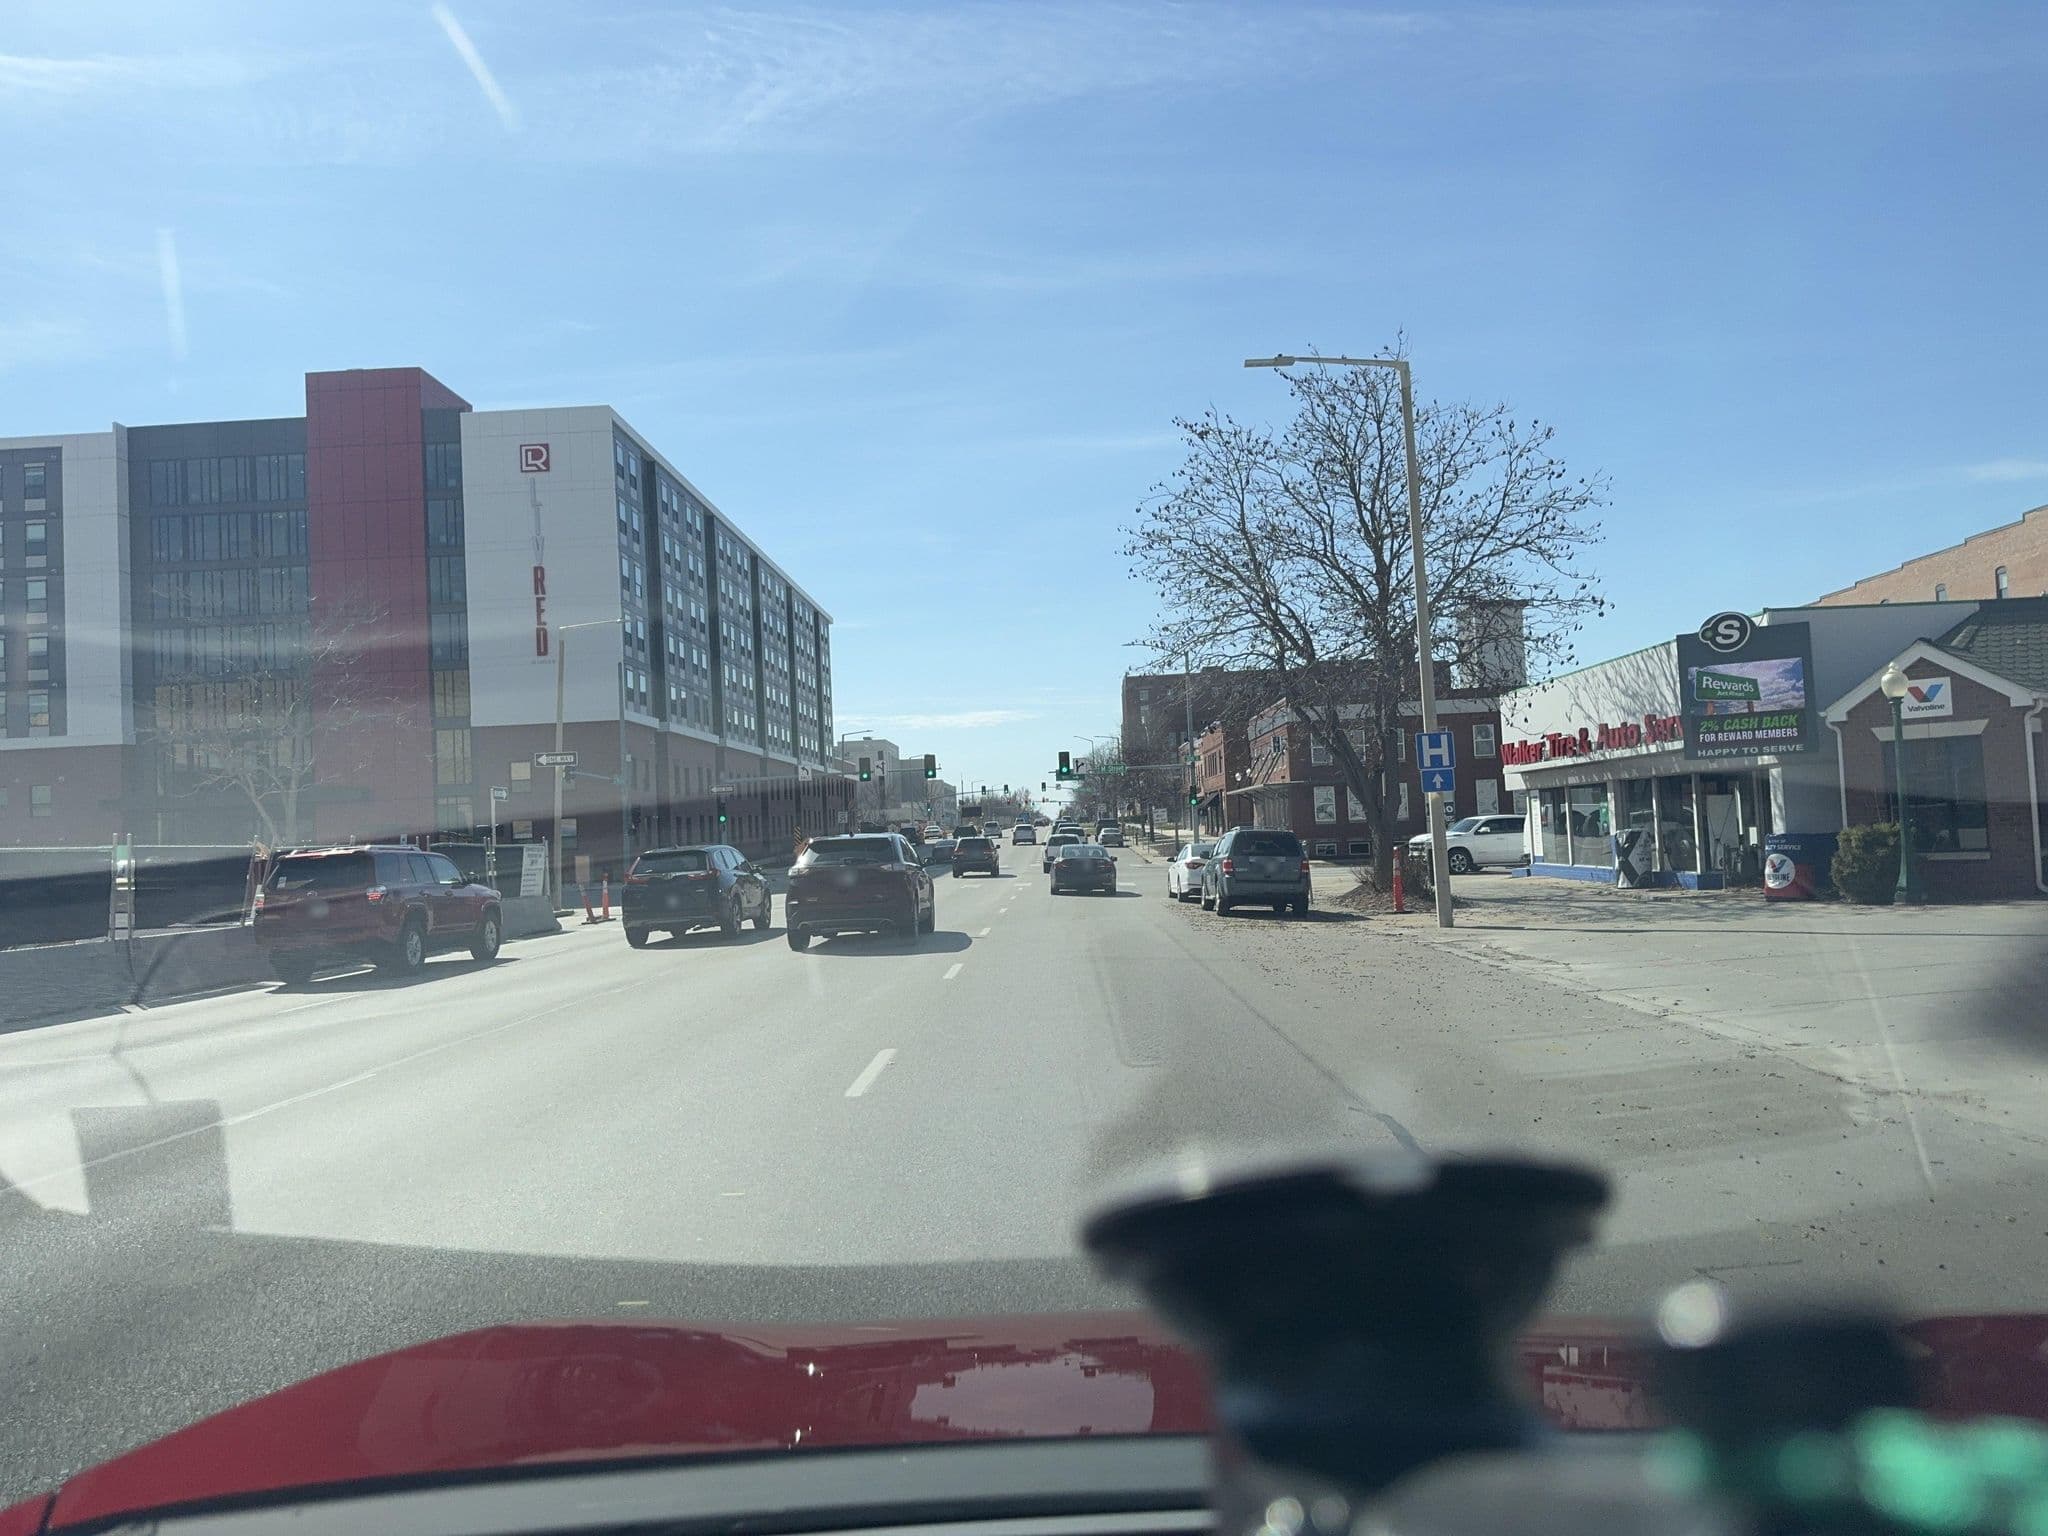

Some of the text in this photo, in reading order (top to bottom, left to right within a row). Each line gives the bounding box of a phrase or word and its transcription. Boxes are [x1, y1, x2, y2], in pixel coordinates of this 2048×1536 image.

[1702, 676, 1755, 693] Rewards
[1907, 703, 1945, 712] Valvoline
[1699, 714, 1798, 733] 2% CASH BACK
[1500, 740, 1545, 766] Walker
[1545, 733, 1577, 758] Tire
[1578, 727, 1592, 753] &
[1597, 722, 1641, 750] Auto
[1699, 727, 1799, 744] FOR REWARD MEMBERS
[1421, 734, 1450, 767] H
[1697, 744, 1805, 758] HAPPY TO SERVE
